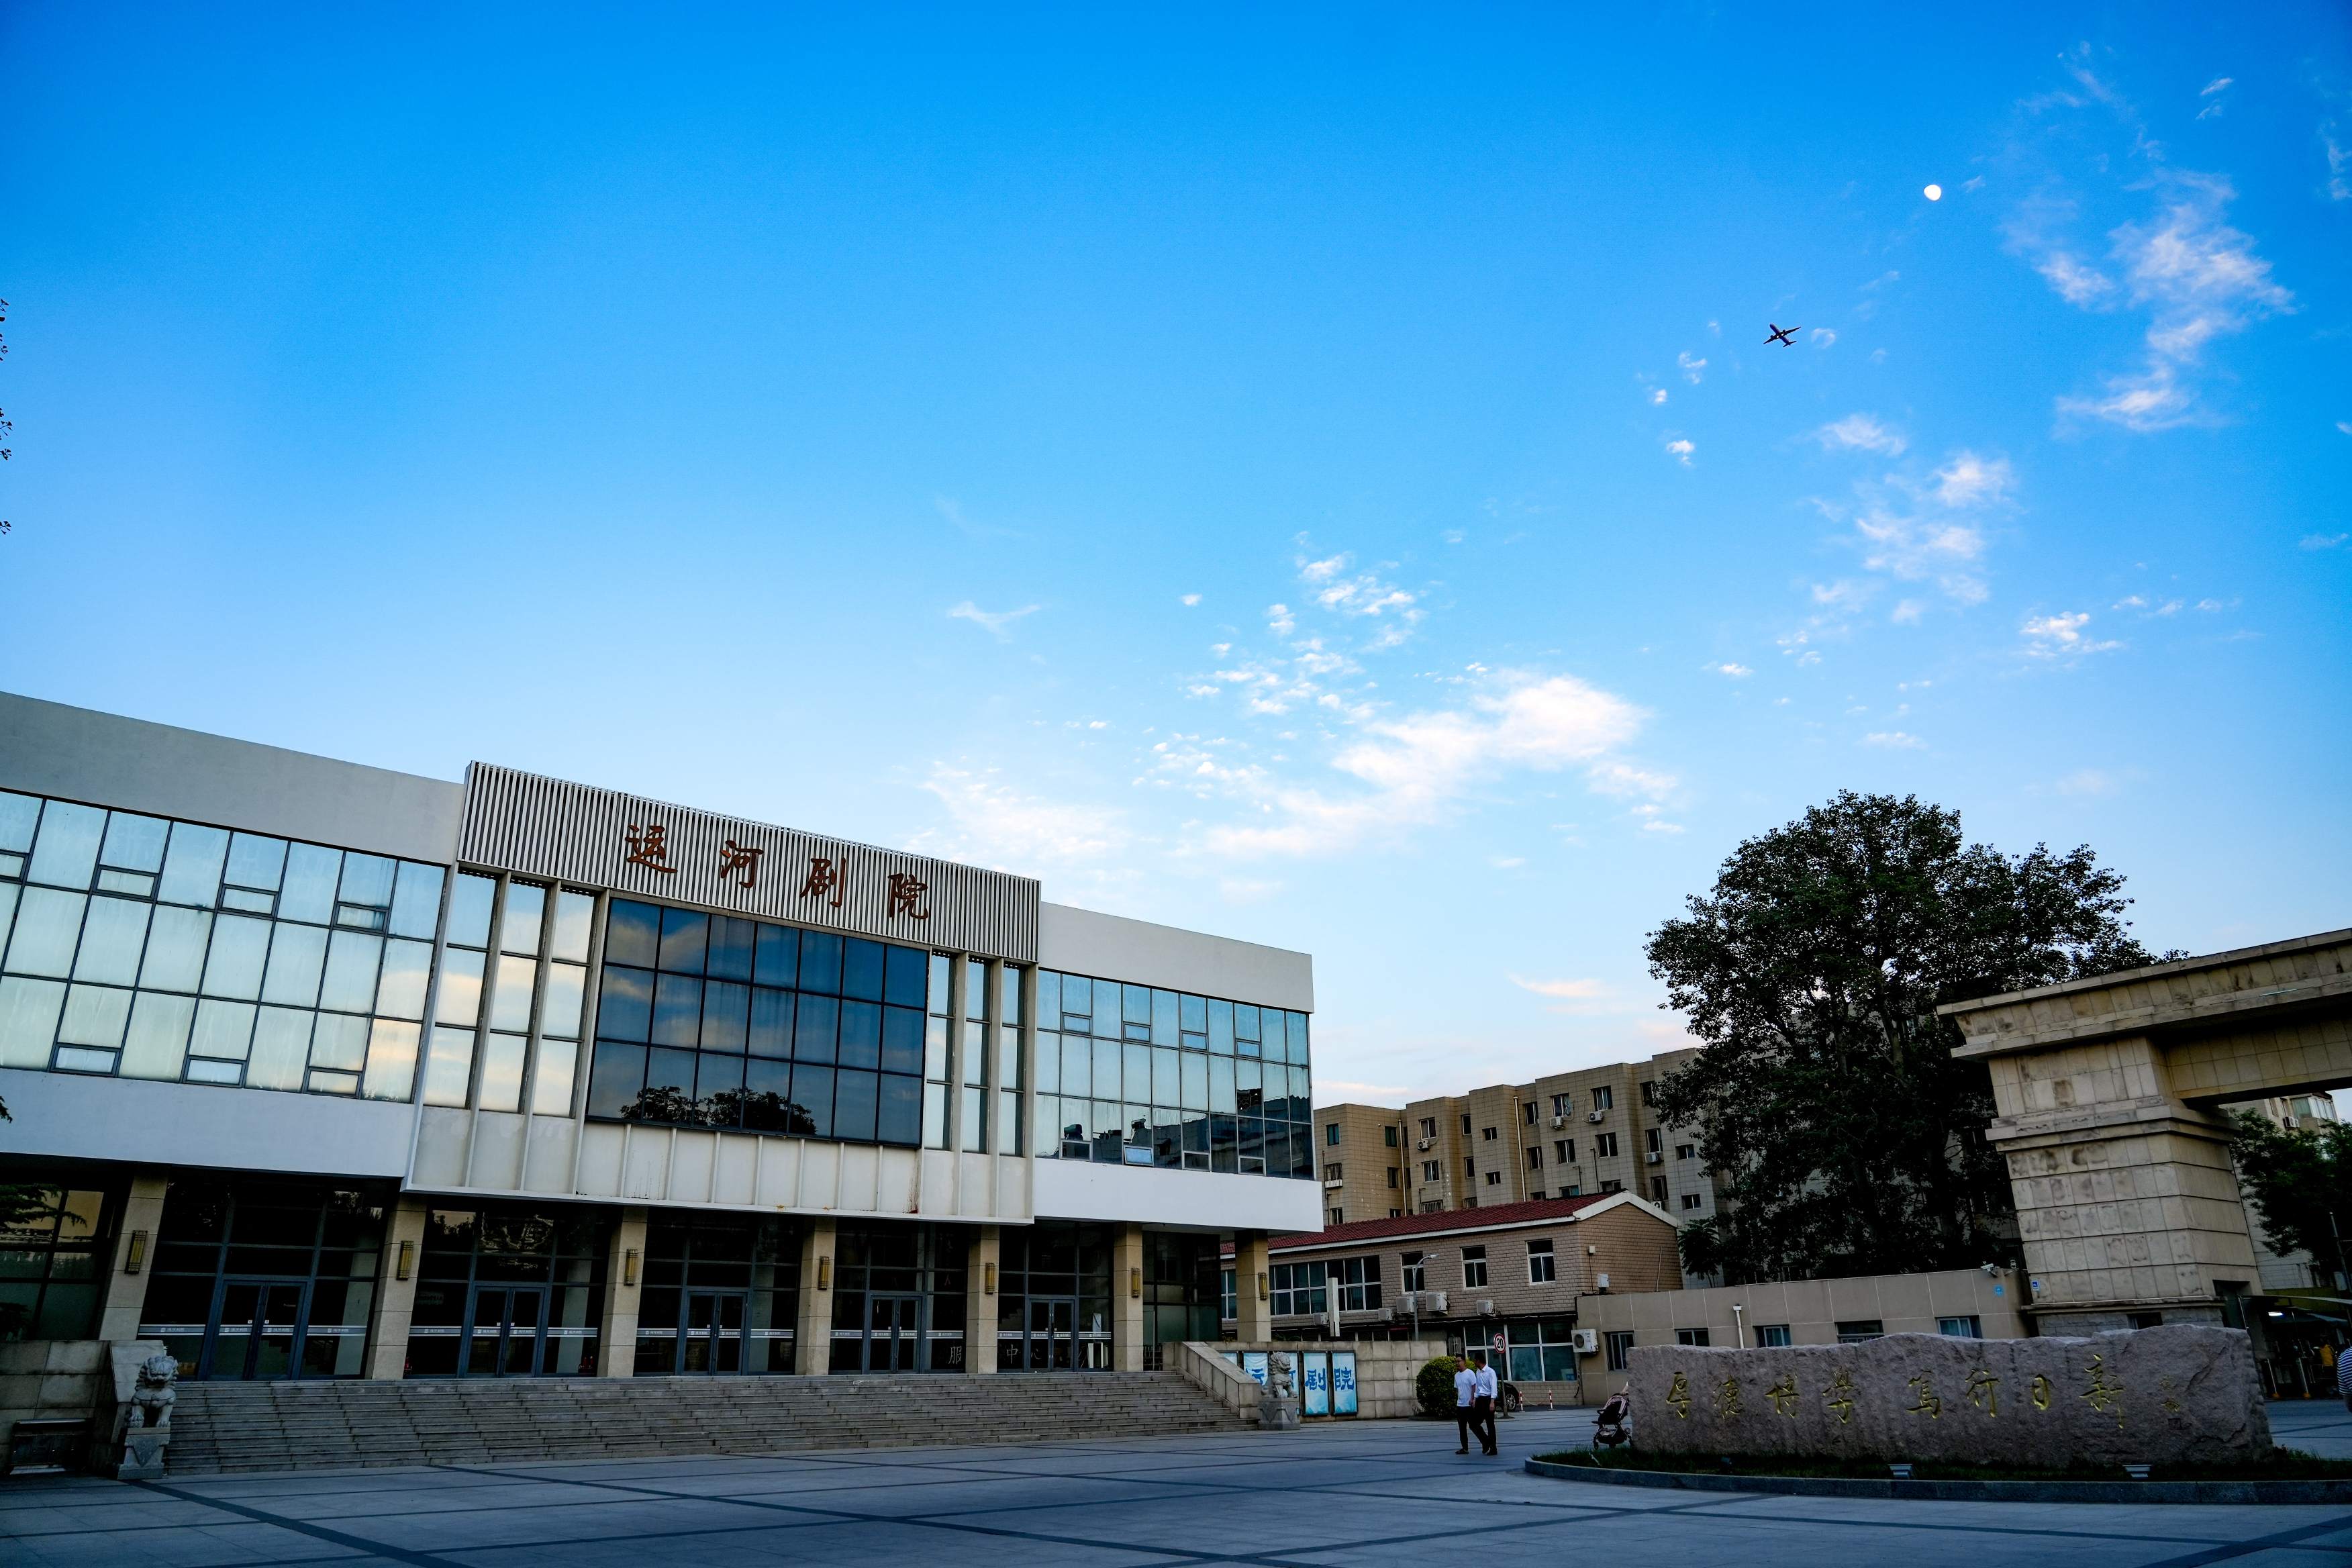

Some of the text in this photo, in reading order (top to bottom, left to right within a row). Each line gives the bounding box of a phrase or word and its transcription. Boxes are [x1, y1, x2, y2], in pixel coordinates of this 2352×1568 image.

[625, 824, 928, 919] 运河剧院
[1497, 1338, 1504, 1349] 20
